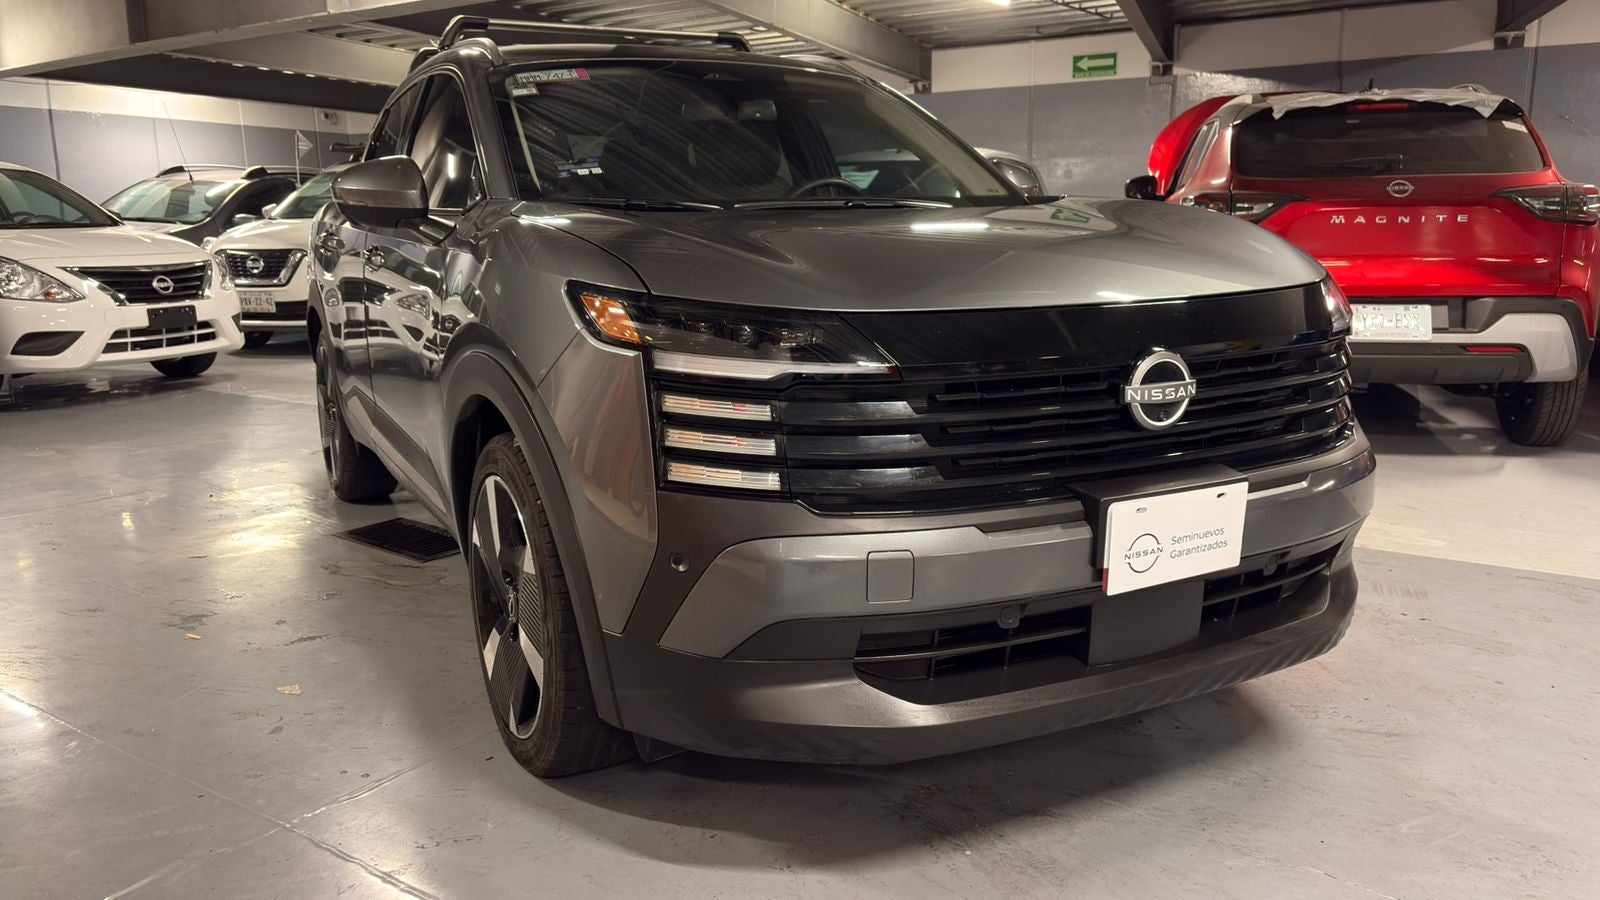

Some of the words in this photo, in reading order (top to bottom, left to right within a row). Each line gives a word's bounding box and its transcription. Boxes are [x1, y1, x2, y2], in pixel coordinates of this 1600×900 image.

[1330, 214, 1469, 224] MAGNITE
[1127, 383, 1196, 401] NISSAN
[1171, 527, 1225, 546] Seminuevos
[1124, 546, 1164, 560] NISSAN
[1169, 539, 1228, 559] Garantizados
